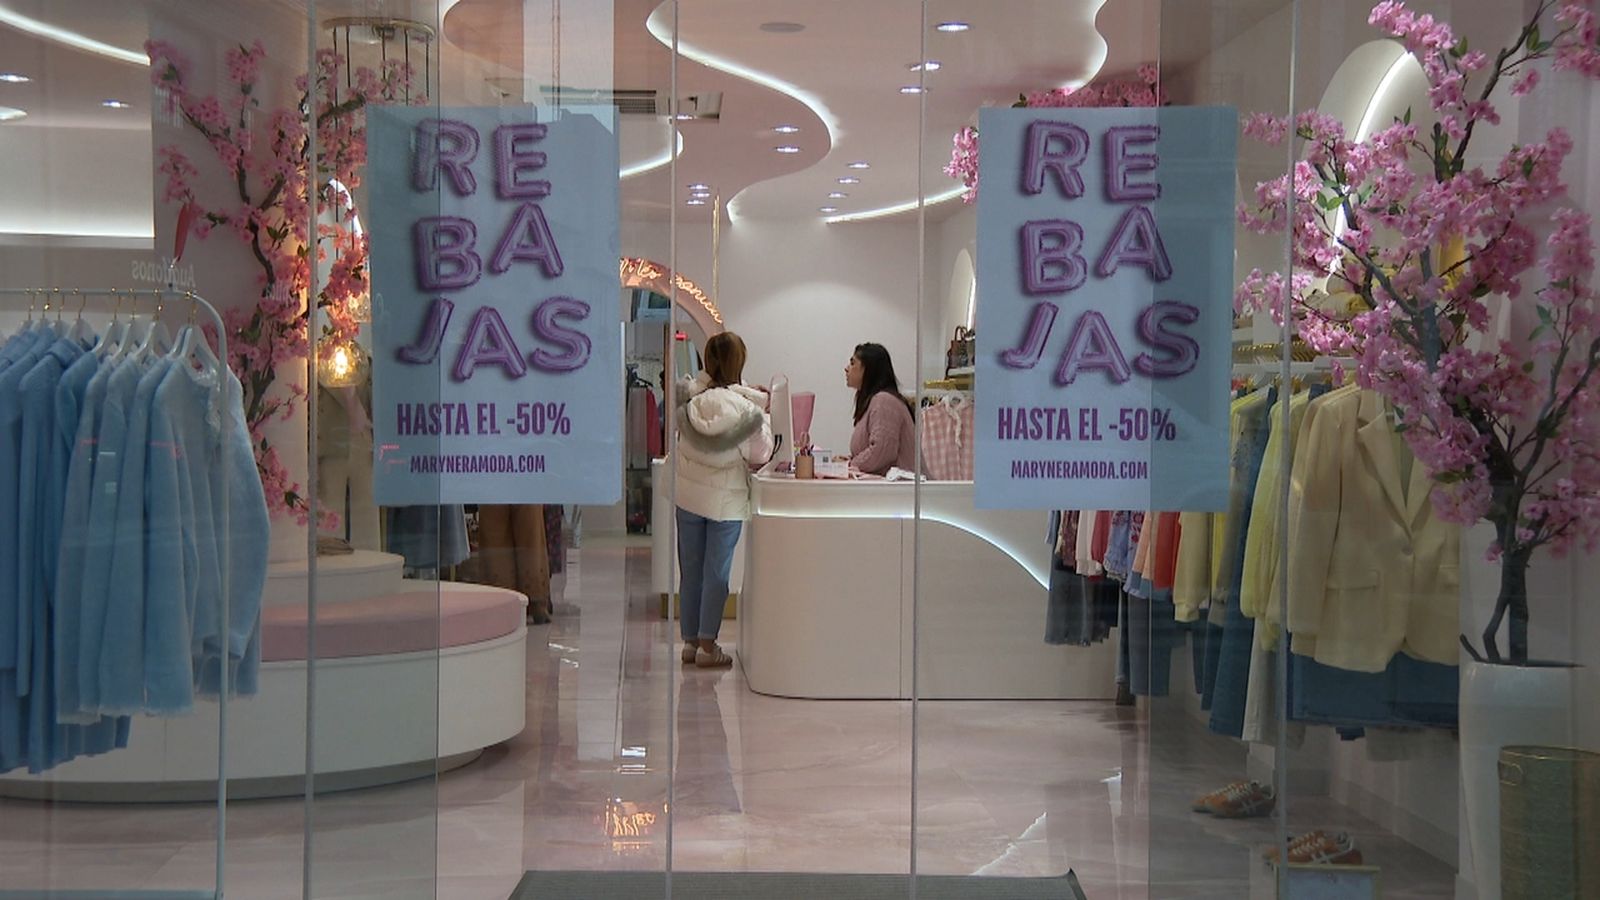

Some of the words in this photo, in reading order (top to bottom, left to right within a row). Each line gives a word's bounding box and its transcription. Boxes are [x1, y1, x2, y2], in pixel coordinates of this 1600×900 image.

[412, 118, 553, 199] RE
[1023, 119, 1162, 202] RE
[414, 202, 564, 291] BA
[1020, 204, 1173, 295] BA
[396, 297, 592, 382] JAS
[1001, 301, 1200, 385] JAS
[397, 403, 469, 436] HASTA
[477, 403, 501, 436] EL
[506, 402, 571, 436] -50%
[998, 408, 1071, 441] HASTA
[1079, 408, 1102, 441] EL
[1109, 408, 1176, 441] -50%
[410, 455, 545, 473] MARYNERAMODA.COM
[1011, 460, 1148, 479] MARYNERAMODA.COM
